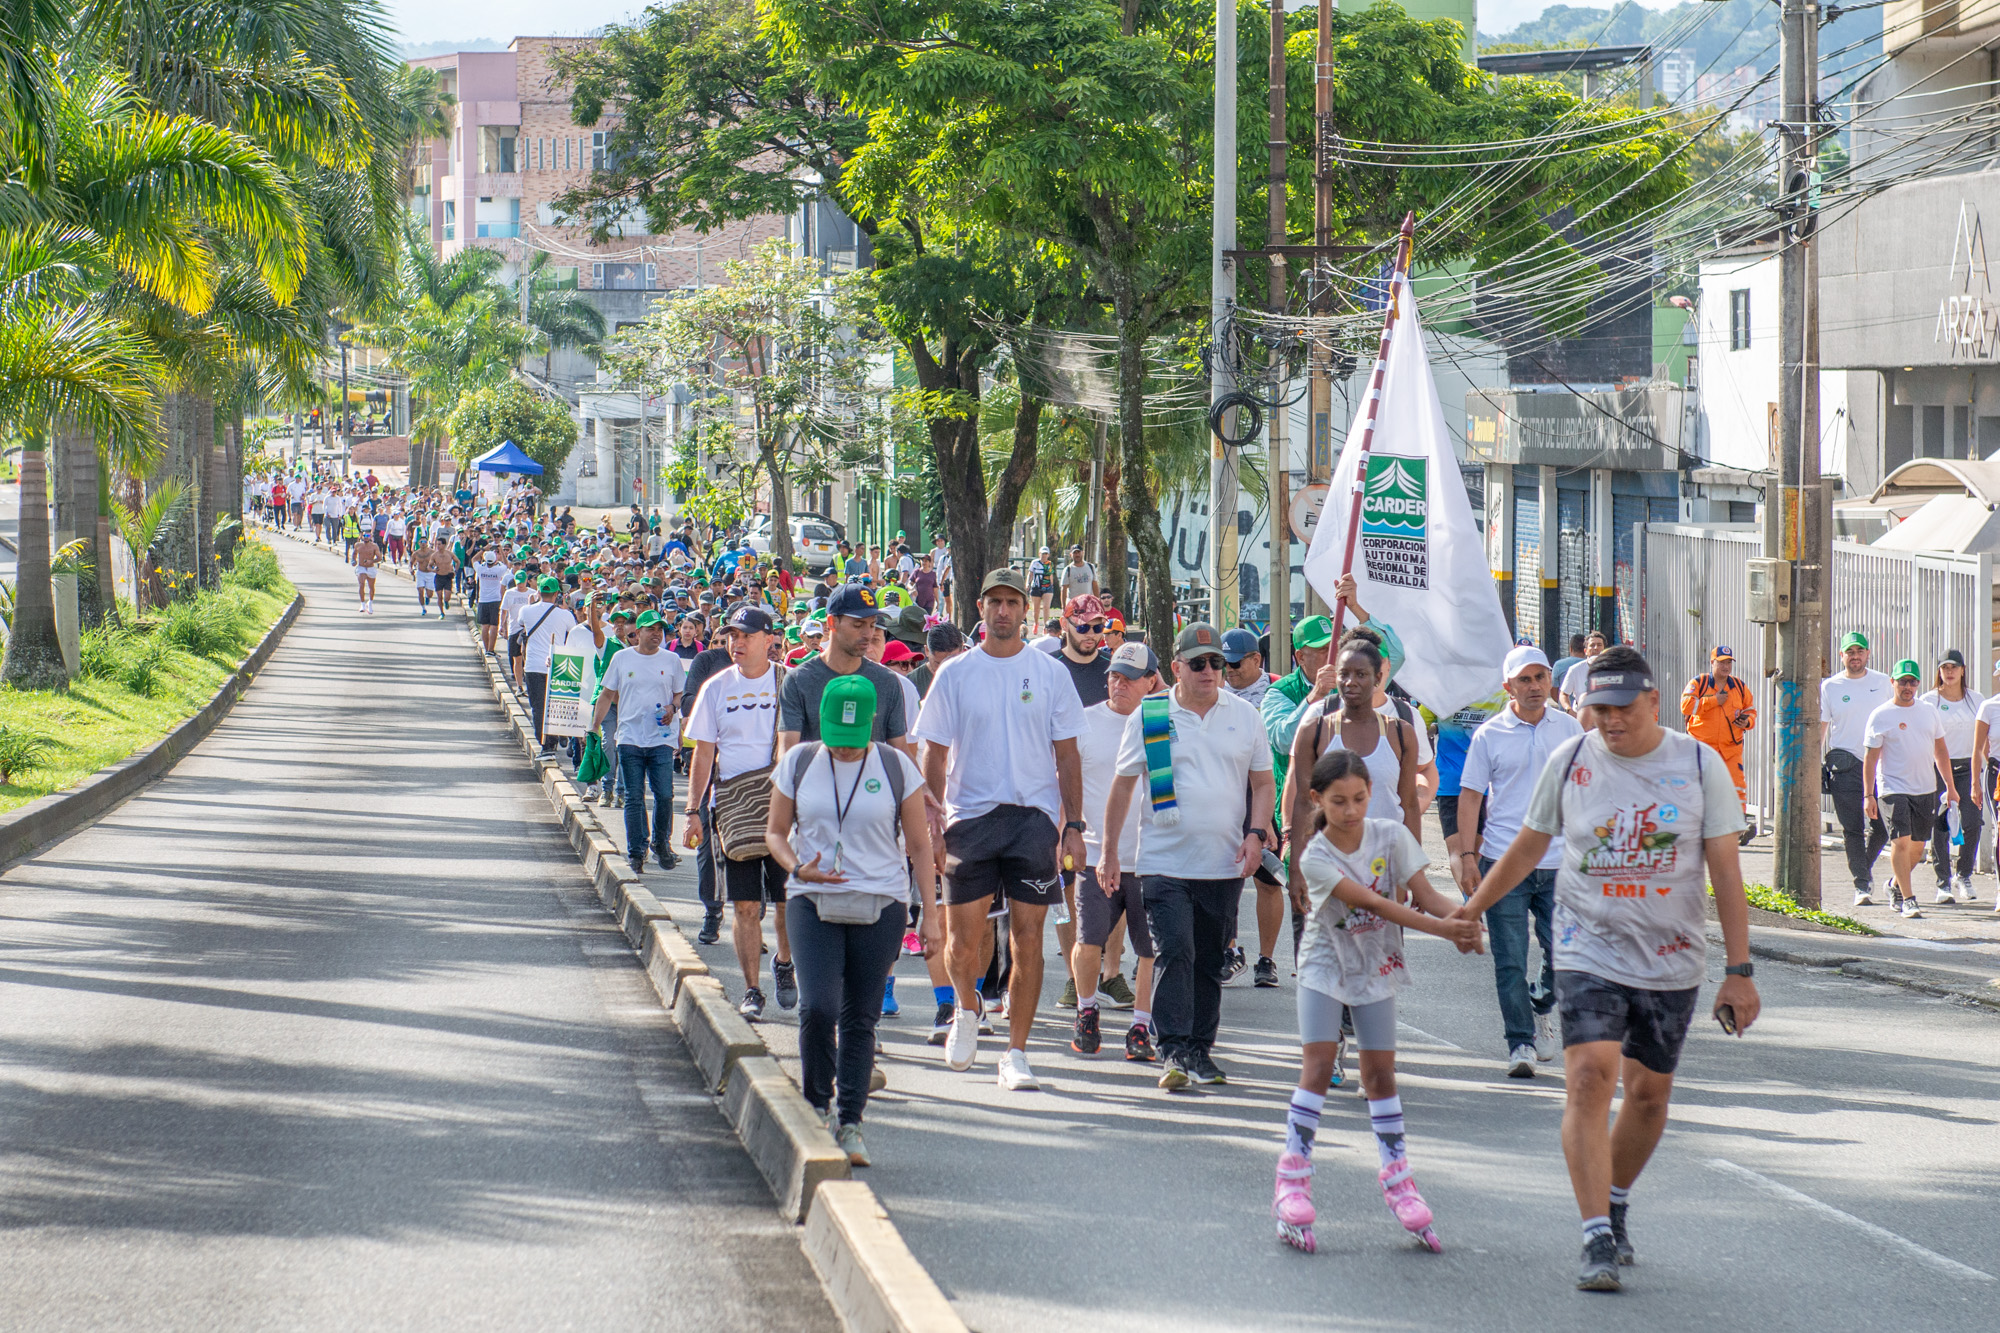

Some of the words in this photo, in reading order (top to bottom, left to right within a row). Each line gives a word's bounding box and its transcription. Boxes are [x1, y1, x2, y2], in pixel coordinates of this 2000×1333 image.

[1518, 416, 1545, 448] CENTRO
[1545, 417, 1555, 448] DE
[1556, 417, 1604, 450] LUBRICACION
[1363, 496, 1427, 516] CARDER
[1363, 538, 1426, 553] CORPORACION
[1365, 549, 1427, 565] AUTONOMA
[1366, 560, 1410, 575] REGIONAL
[1414, 565, 1427, 577] DE
[1368, 570, 1427, 589] RISARALDA
[860, 589, 875, 606] SC
[551, 679, 581, 688] CARDER
[1602, 883, 1646, 898] EMI
